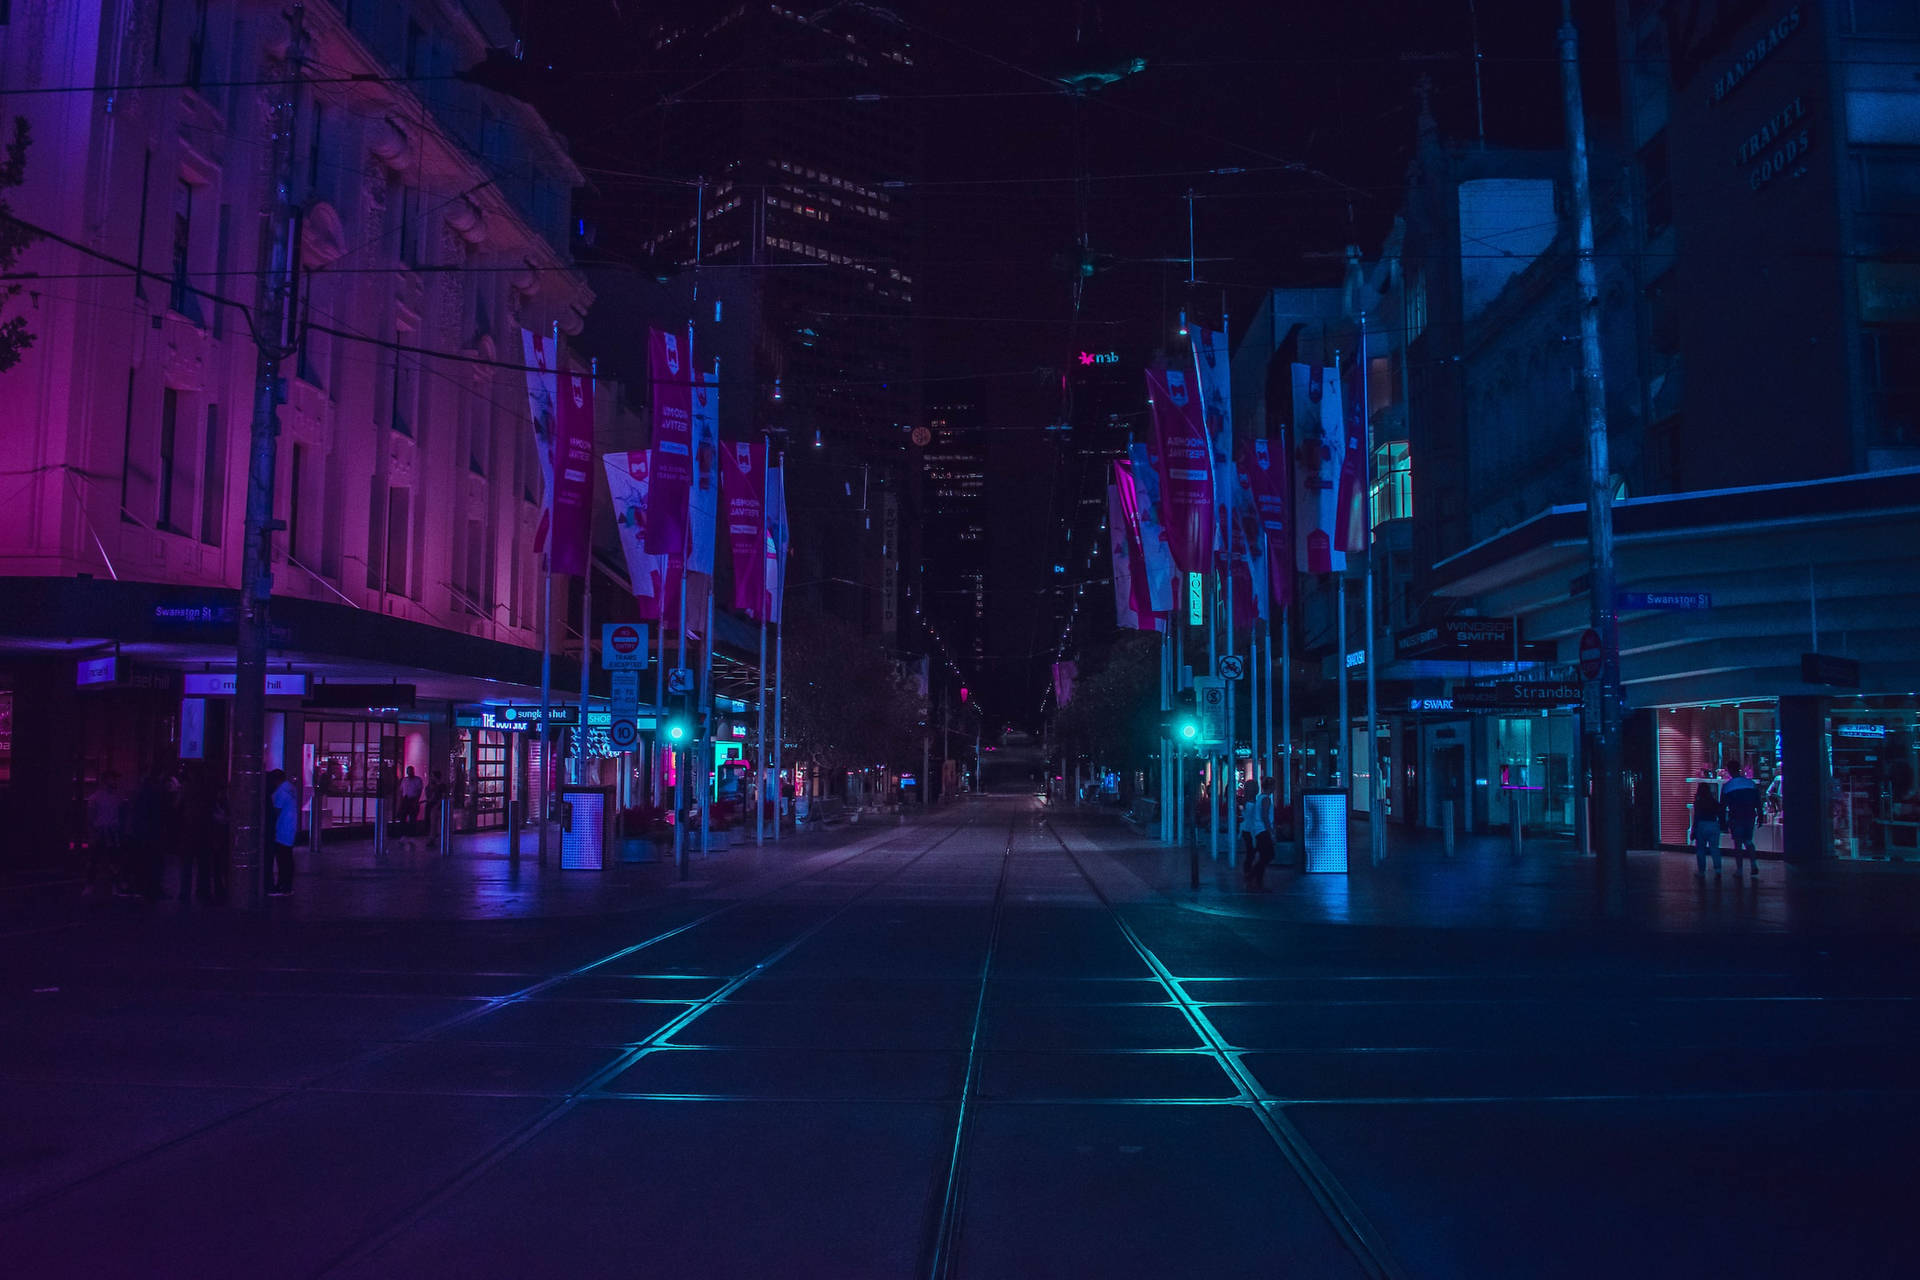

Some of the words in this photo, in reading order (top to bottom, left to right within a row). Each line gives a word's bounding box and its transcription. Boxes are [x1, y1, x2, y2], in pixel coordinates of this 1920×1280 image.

[1712, 5, 1800, 101] HANDBAGS
[1736, 97, 1806, 164] TRAVEL
[1751, 128, 1808, 190] GOODS
[1647, 594, 1696, 604] Swanston
[1698, 594, 1708, 604] St
[156, 606, 200, 617] Swanston
[202, 606, 212, 617] St
[1457, 632, 1504, 641] SMITH
[267, 680, 282, 689] hill
[553, 709, 567, 718] hut
[483, 713, 495, 728] THE
[618, 727, 630, 738] 10
